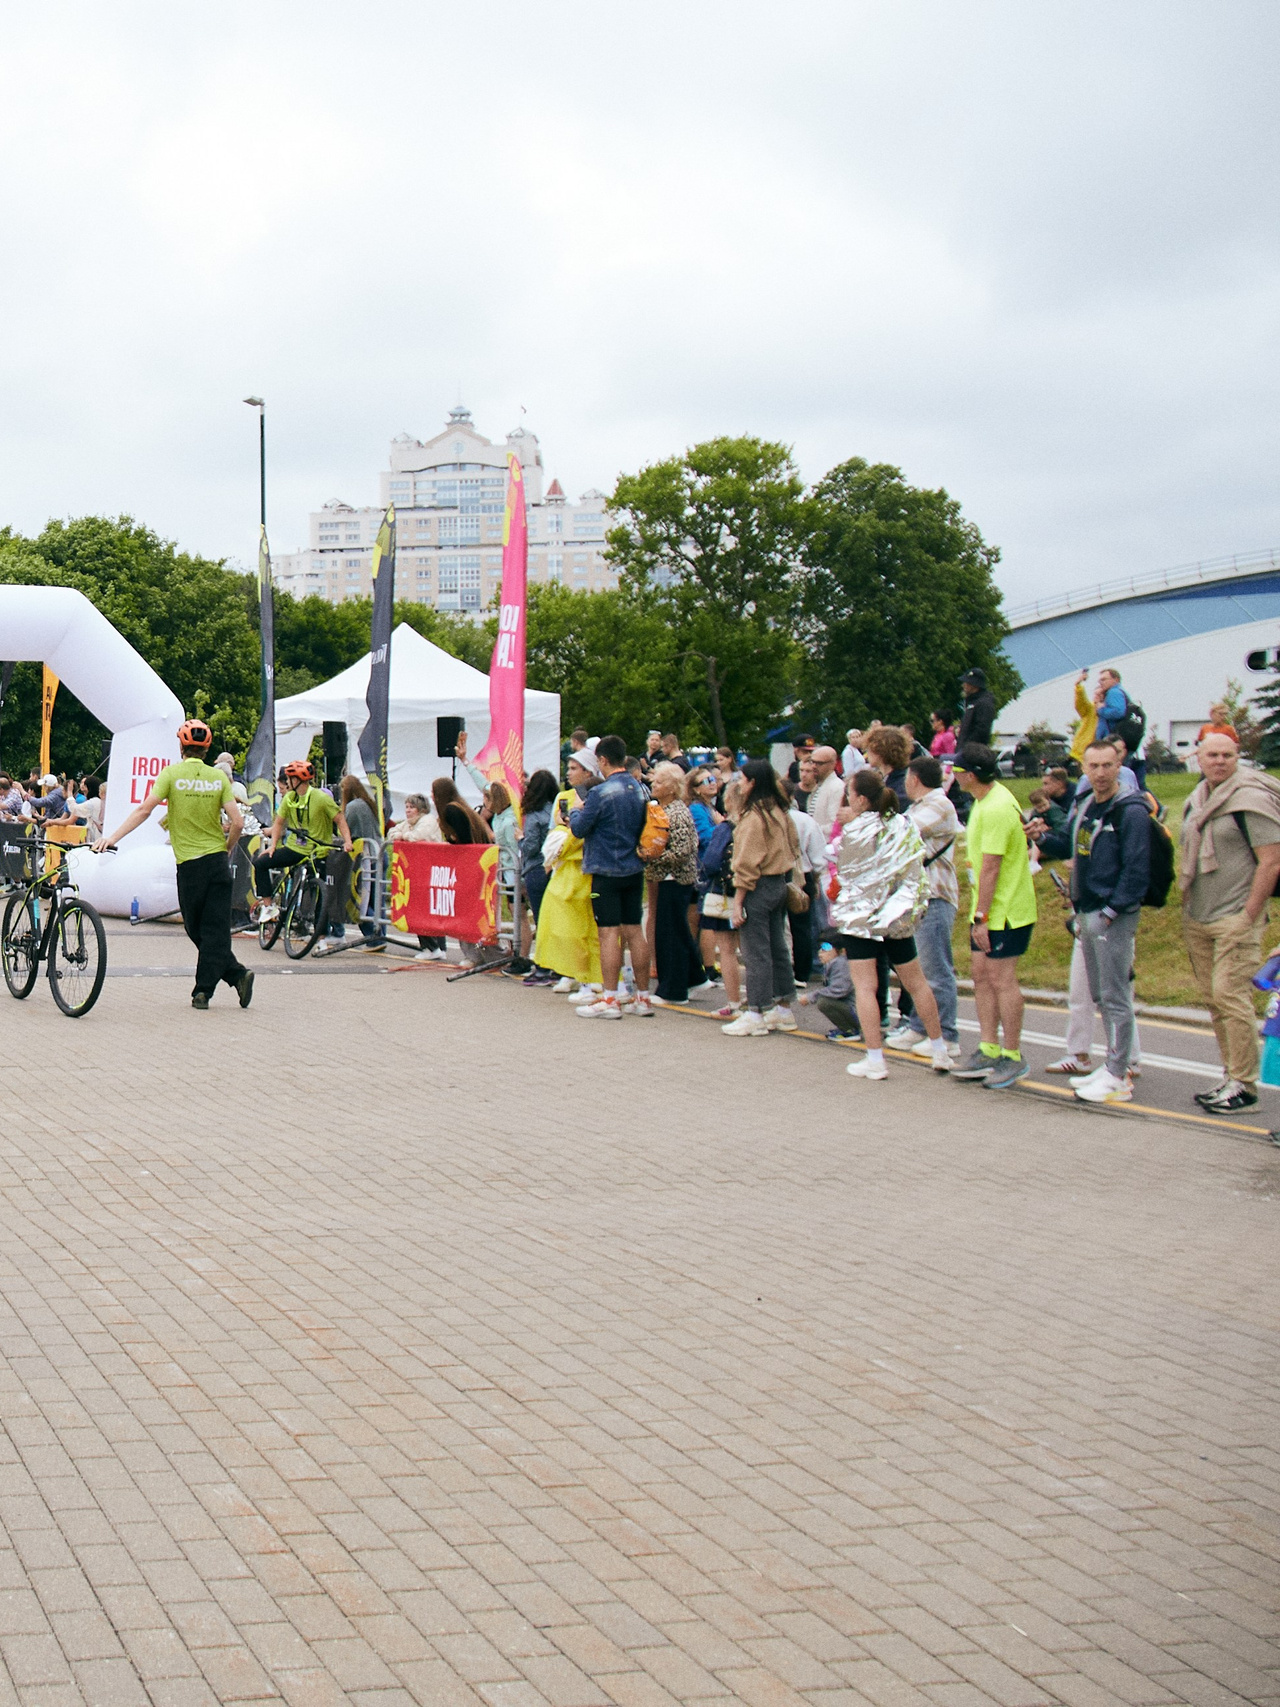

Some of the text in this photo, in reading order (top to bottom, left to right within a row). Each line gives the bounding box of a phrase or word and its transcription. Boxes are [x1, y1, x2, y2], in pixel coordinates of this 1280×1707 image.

[175, 778, 223, 792] СУДЬЯ
[430, 865, 451, 888] IRON
[429, 887, 456, 918] LADY
